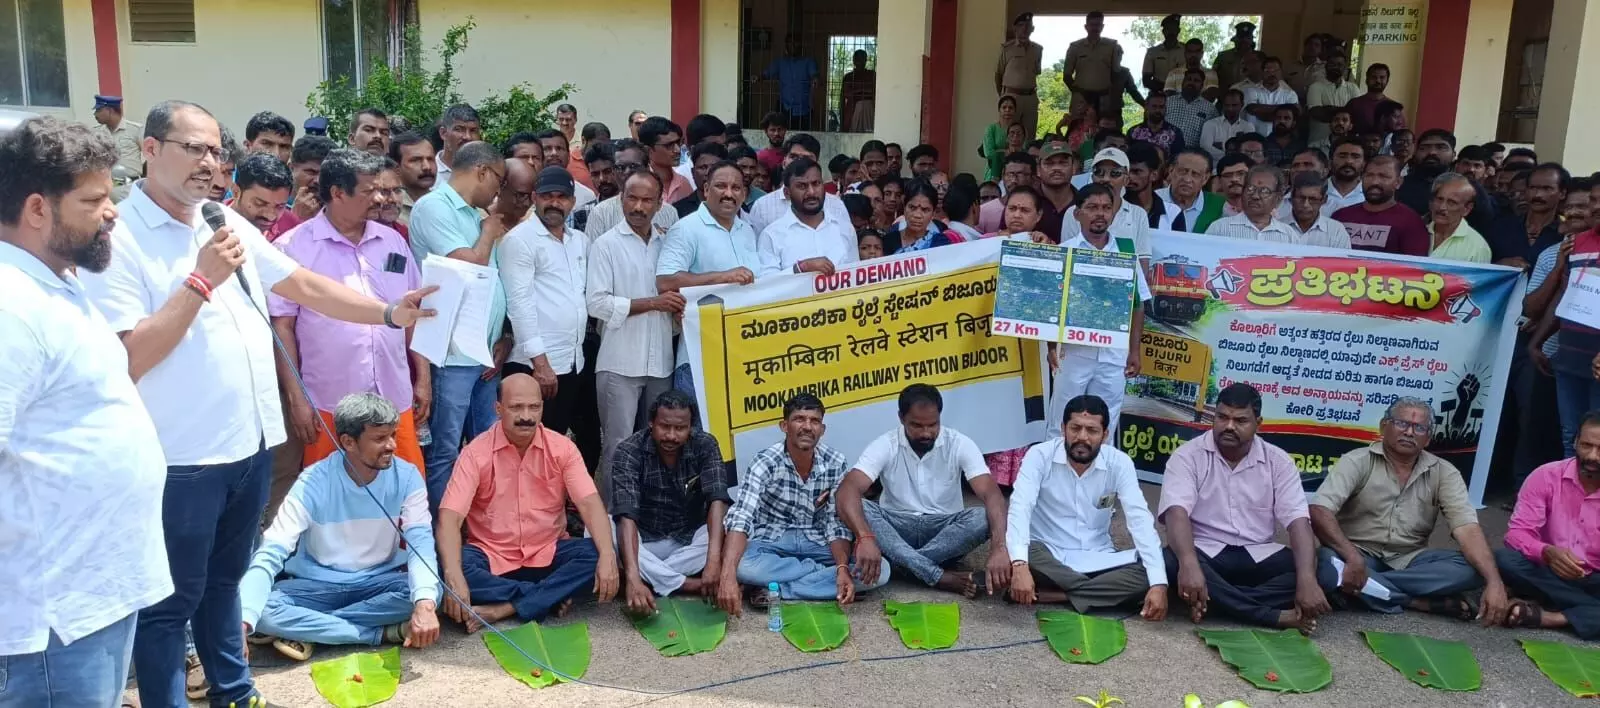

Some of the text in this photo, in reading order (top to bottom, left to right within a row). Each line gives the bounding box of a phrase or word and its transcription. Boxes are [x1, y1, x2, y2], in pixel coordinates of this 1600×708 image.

[1372, 33, 1417, 42] PARKING
[815, 257, 927, 293] OUR DEMAND
[1246, 260, 1445, 310] ಪ್ರತಿಭಟನೆ
[741, 308, 847, 340] ಮೂಕಾಂಬಿಕಾ
[994, 321, 1039, 336] 27 Km
[1067, 329, 1112, 345] 30 Km
[1230, 319, 1277, 339] ಕೊಲ್ಲೂರಿಗೆ
[1343, 330, 1364, 348] ರೈಲು
[743, 312, 993, 385] मूकाम्बिका रेलवे स्टेशन बिजू
[1141, 333, 1189, 352] ಬಿಜೂರು
[1145, 347, 1192, 364] BIJURU
[1218, 338, 1256, 353] ಬಿಜೂರು
[1258, 341, 1279, 359] ರೈಲು
[1331, 350, 1377, 366] ಯಾವುದೇ
[1427, 358, 1448, 375] ರೈಲು
[743, 346, 1009, 413] MOOKAMBIKA RAILWAY STATION BIJOOR
[1153, 360, 1179, 376] बिजूर
[1226, 358, 1271, 374] ನಿಲುಗಡೆಗೆ
[1334, 369, 1362, 383] ಕುರಿತು
[1364, 373, 1394, 386] ಹಾಗೂ
[1396, 376, 1434, 391] ಬಿಜೂರು
[1282, 384, 1301, 396] ಆದ
[1286, 402, 1361, 422] ಕೋರಿ ಪ್ರತಿಭಟನೆ
[1122, 424, 1156, 462] ರೈಲ್ವೆ
